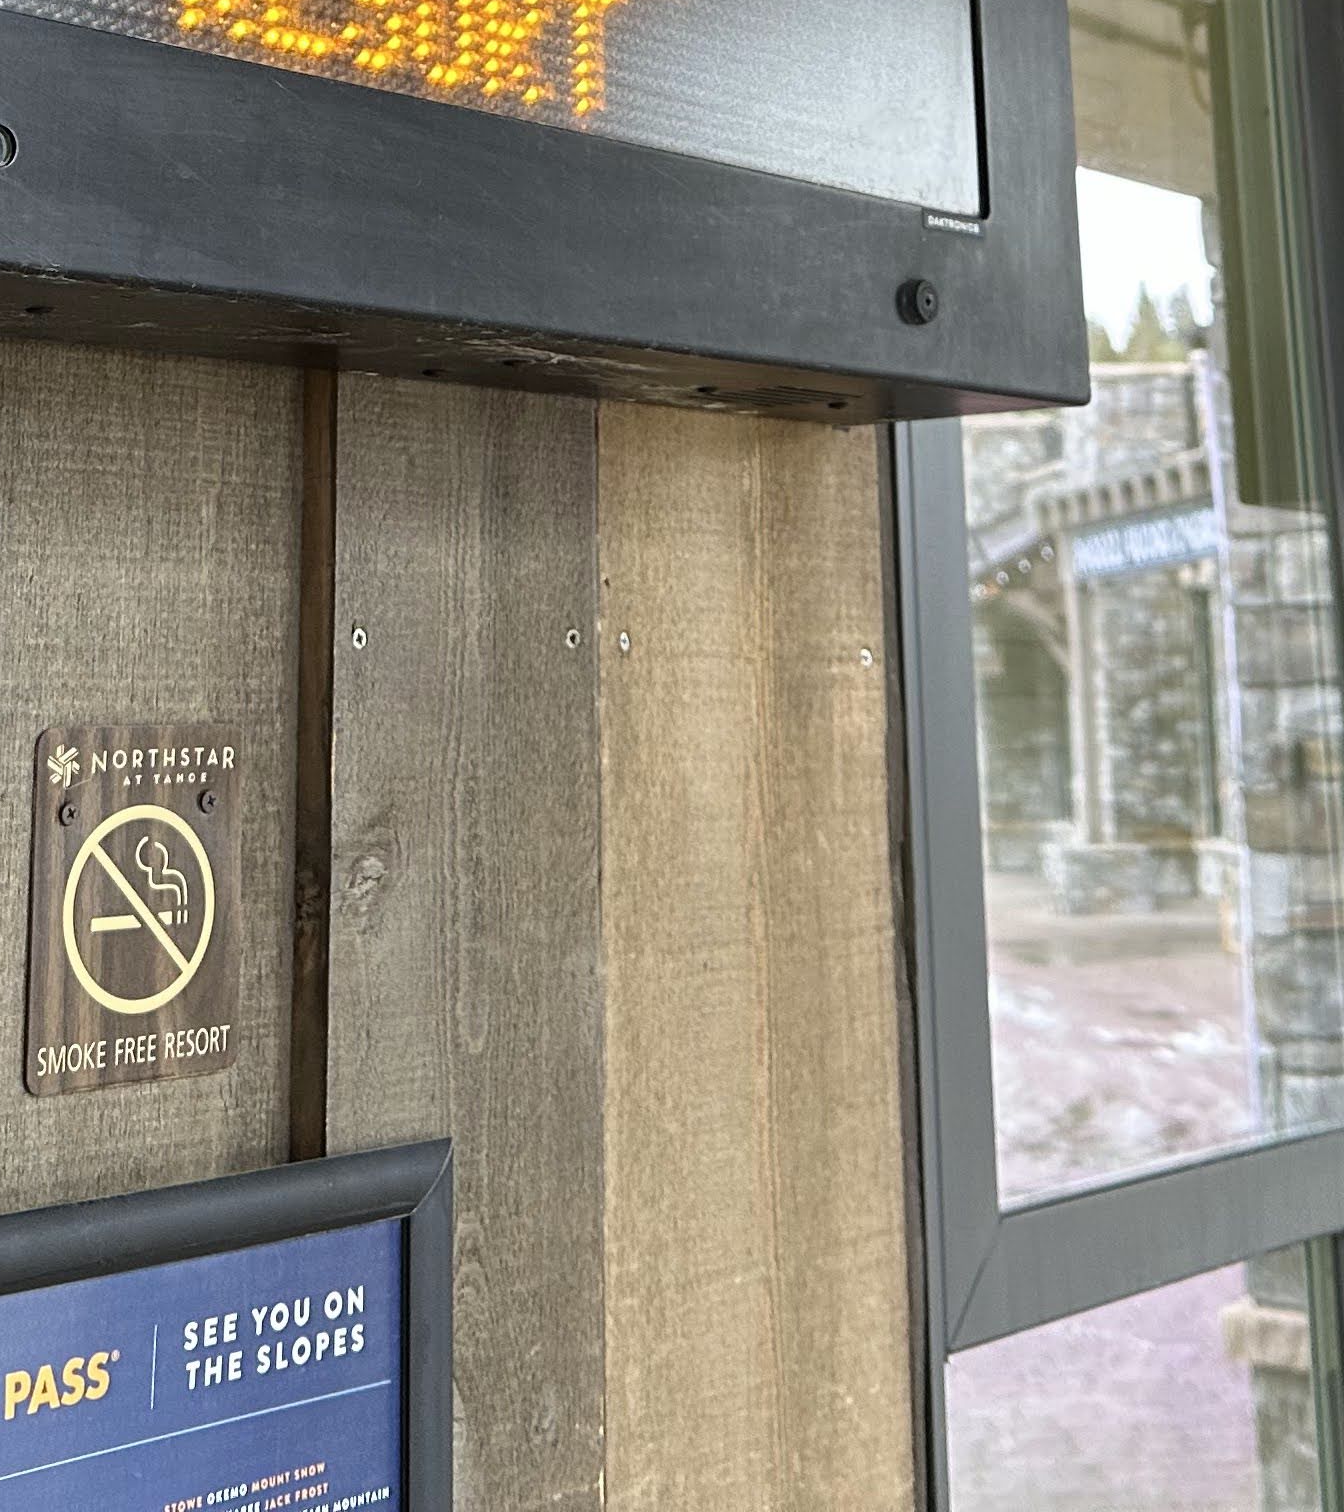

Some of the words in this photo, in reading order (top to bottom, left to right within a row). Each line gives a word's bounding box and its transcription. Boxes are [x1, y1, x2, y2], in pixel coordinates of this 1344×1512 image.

[91, 746, 235, 774] NORTHSTAR
[123, 774, 143, 786] AT
[154, 772, 207, 786] TAHOE
[37, 1040, 107, 1077] SMOKE
[114, 1034, 157, 1066] FREE
[164, 1024, 231, 1060] RESORT
[183, 1312, 238, 1351] SEE
[251, 1296, 311, 1336] YOU
[323, 1285, 364, 1320] ON
[185, 1350, 243, 1390] THE
[256, 1323, 365, 1375] SLOPES
[207, 1483, 248, 1505] OKEMO
[251, 1471, 291, 1493] MOUNT
[294, 1461, 326, 1481] SNOW
[264, 1494, 292, 1511] JACK
[295, 1482, 329, 1502] FROST
[333, 1486, 391, 1512] MOUNTAIN
